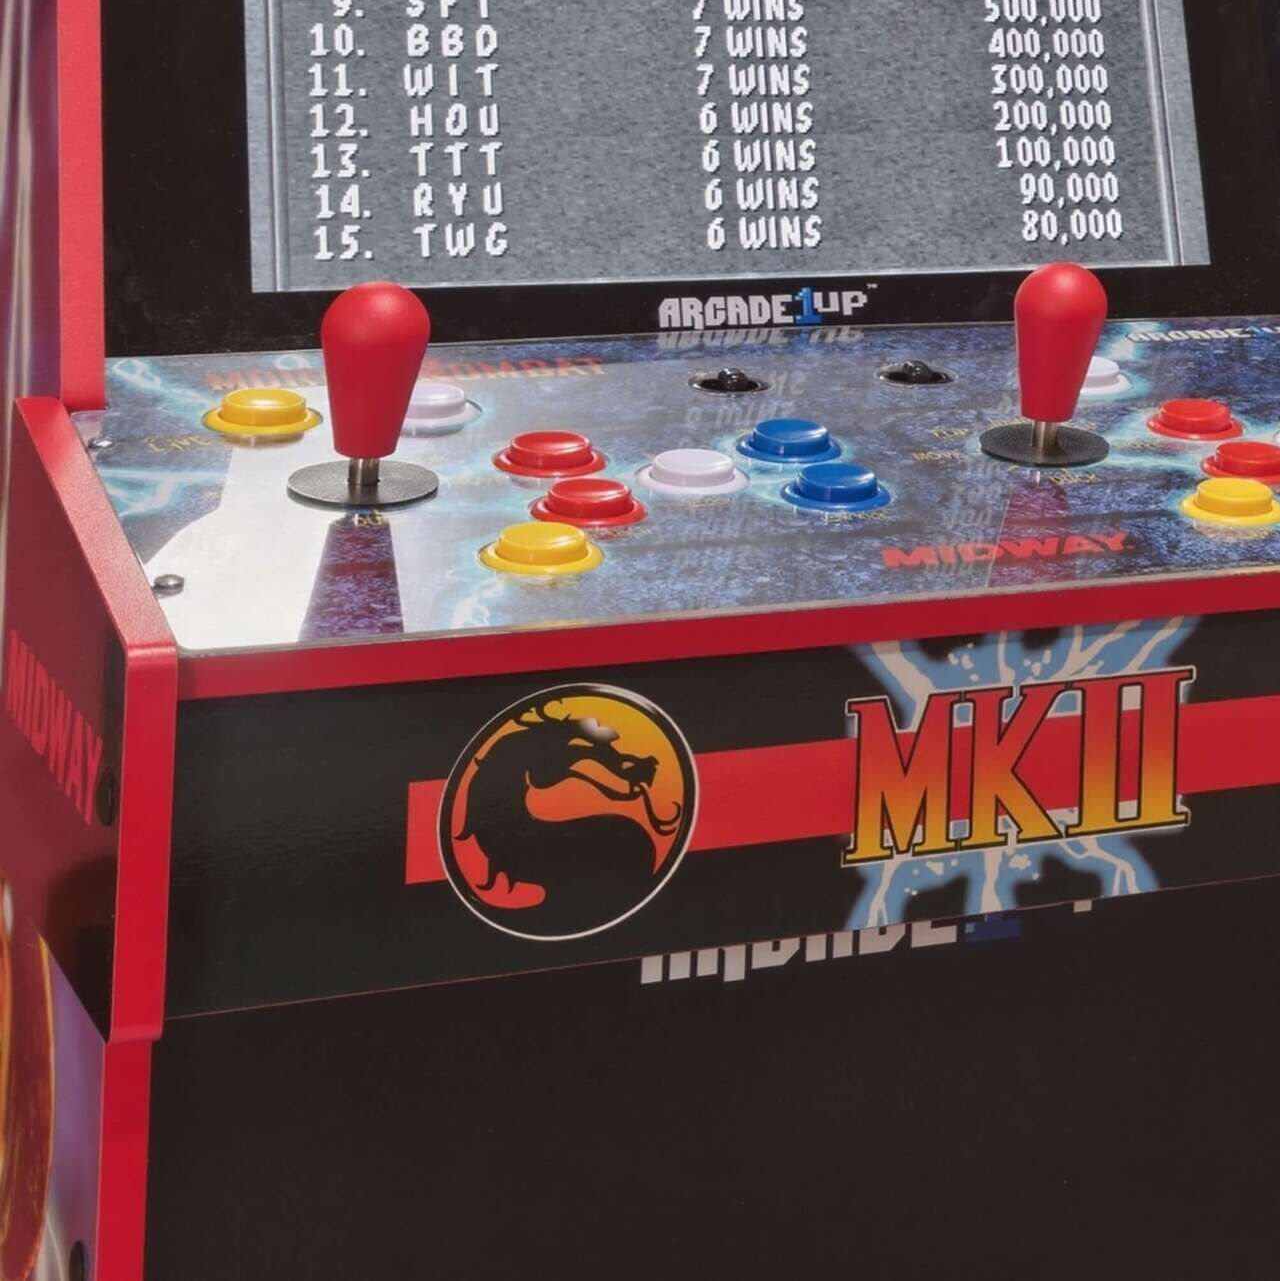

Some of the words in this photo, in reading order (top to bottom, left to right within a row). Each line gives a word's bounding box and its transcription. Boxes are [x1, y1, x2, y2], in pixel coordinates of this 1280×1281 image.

[309, 22, 365, 57] 10.
[406, 23, 498, 57] BBD
[694, 25, 711, 57] 7
[726, 26, 807, 58] WINS
[988, 27, 1105, 63] 400,000
[313, 224, 373, 260] 15.
[413, 221, 508, 257] TWG
[707, 217, 725, 250] 6
[739, 214, 822, 249] WINS
[1021, 208, 1123, 245] 80,000
[657, 285, 868, 330] ARCADE1UP
[879, 531, 1128, 570] MIDWAY
[8, 629, 104, 826] MIDWAY
[841, 664, 1197, 868] MKII
